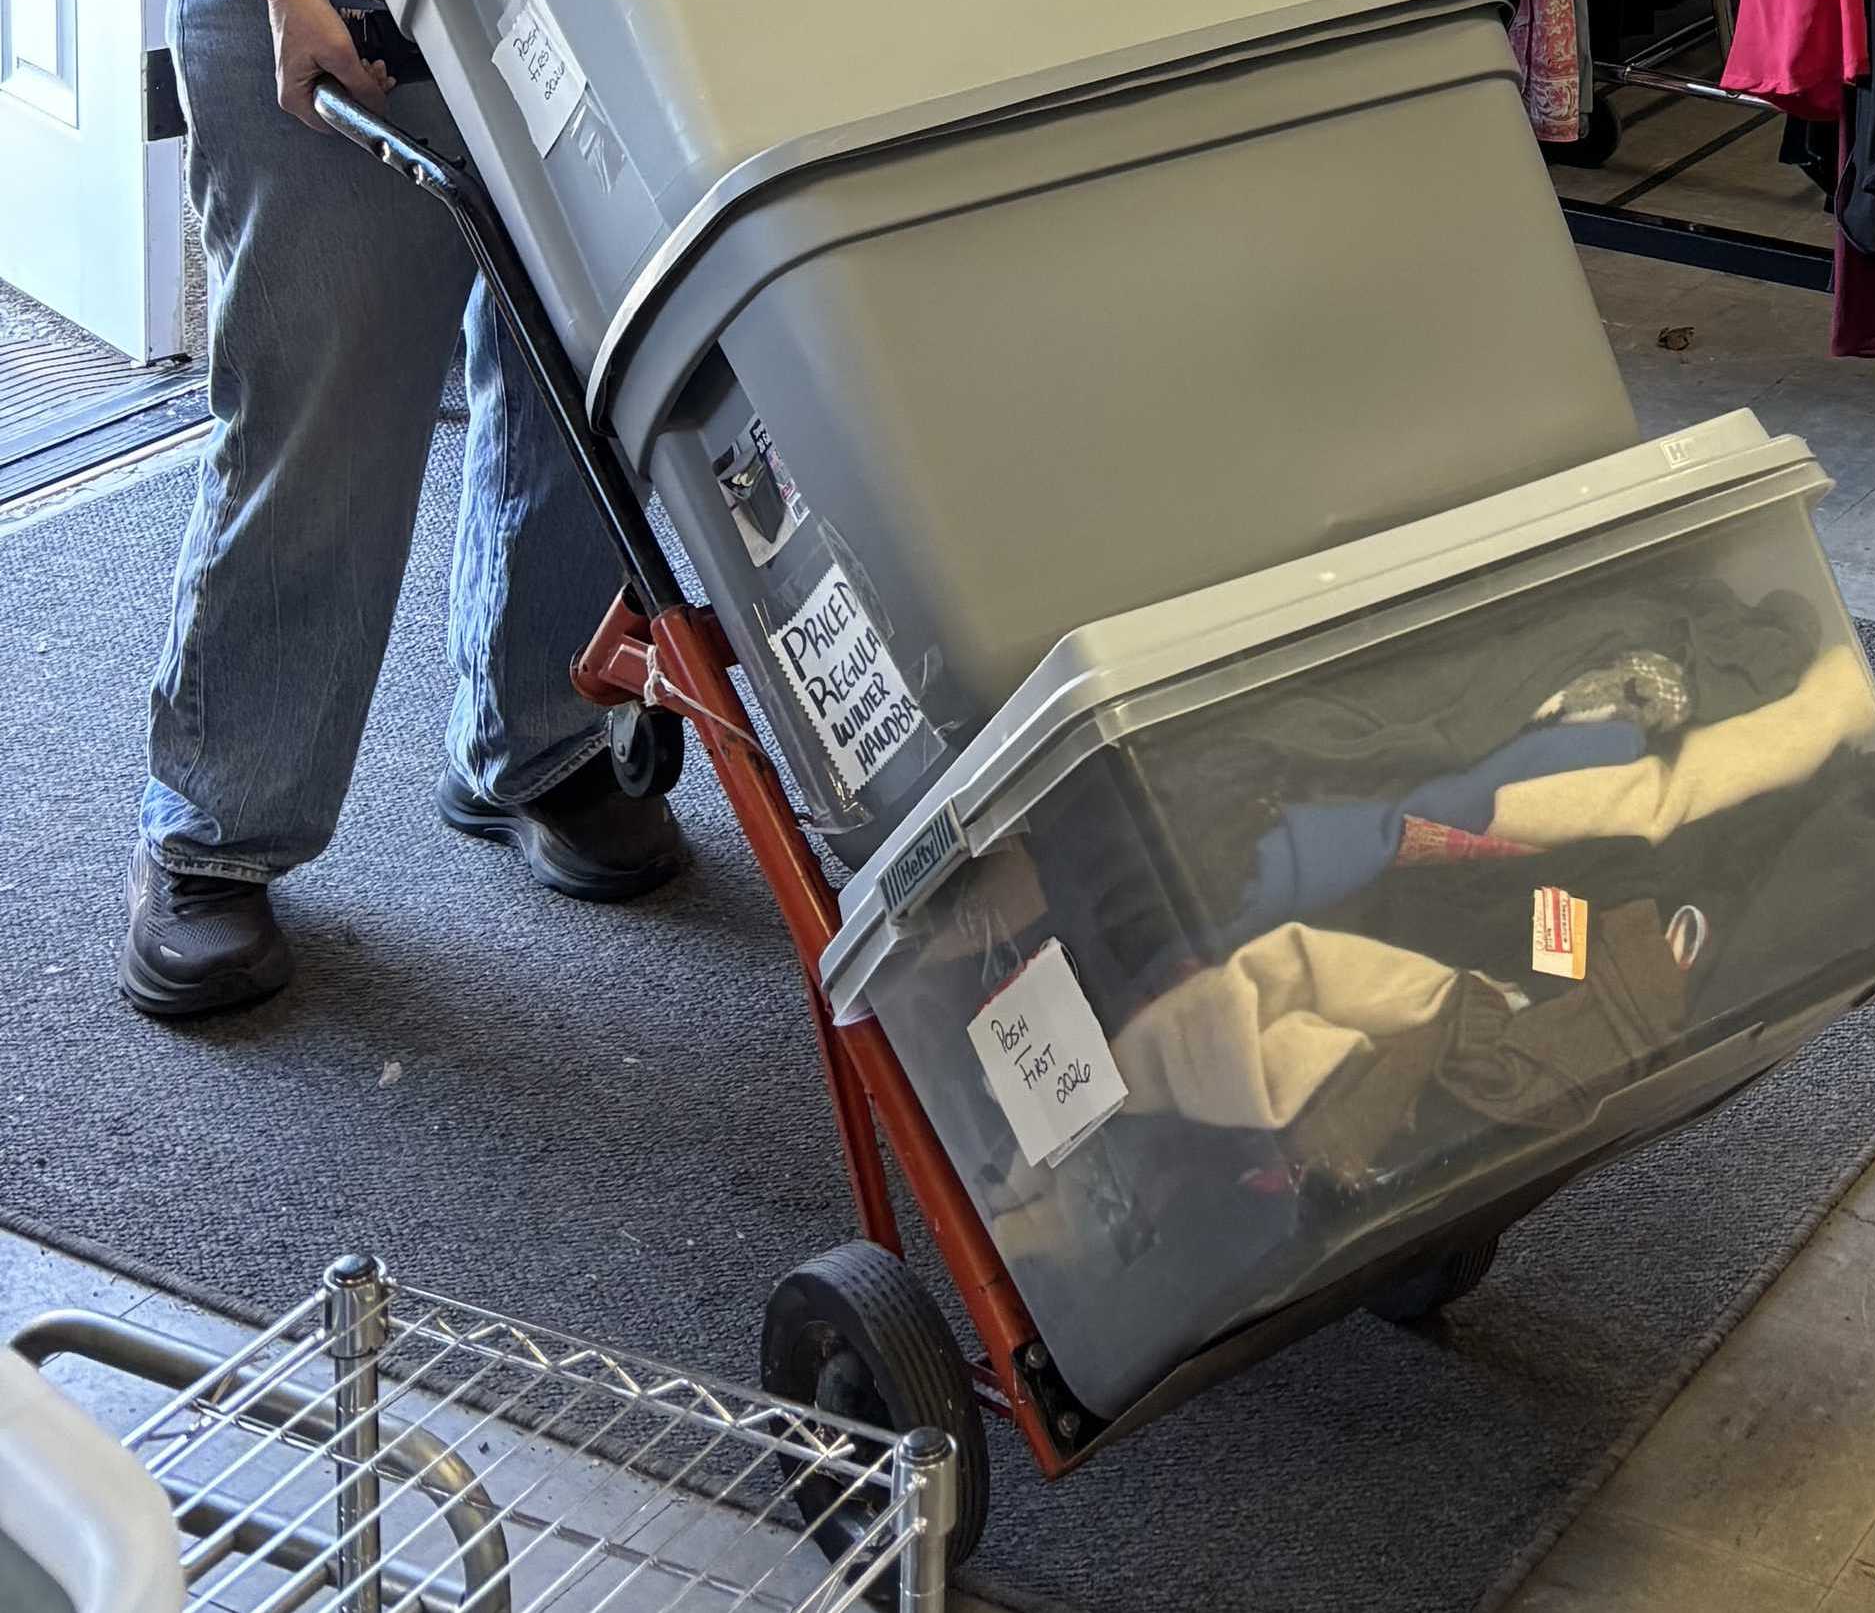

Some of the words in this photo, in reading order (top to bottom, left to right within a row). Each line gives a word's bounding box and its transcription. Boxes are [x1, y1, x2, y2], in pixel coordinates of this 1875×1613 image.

[830, 671, 891, 749] WINTER
[901, 839, 937, 887] Hefty
[991, 1014, 1030, 1053] POSH
[1014, 1043, 1058, 1090] FIRST
[1056, 1057, 1092, 1105] 2026
